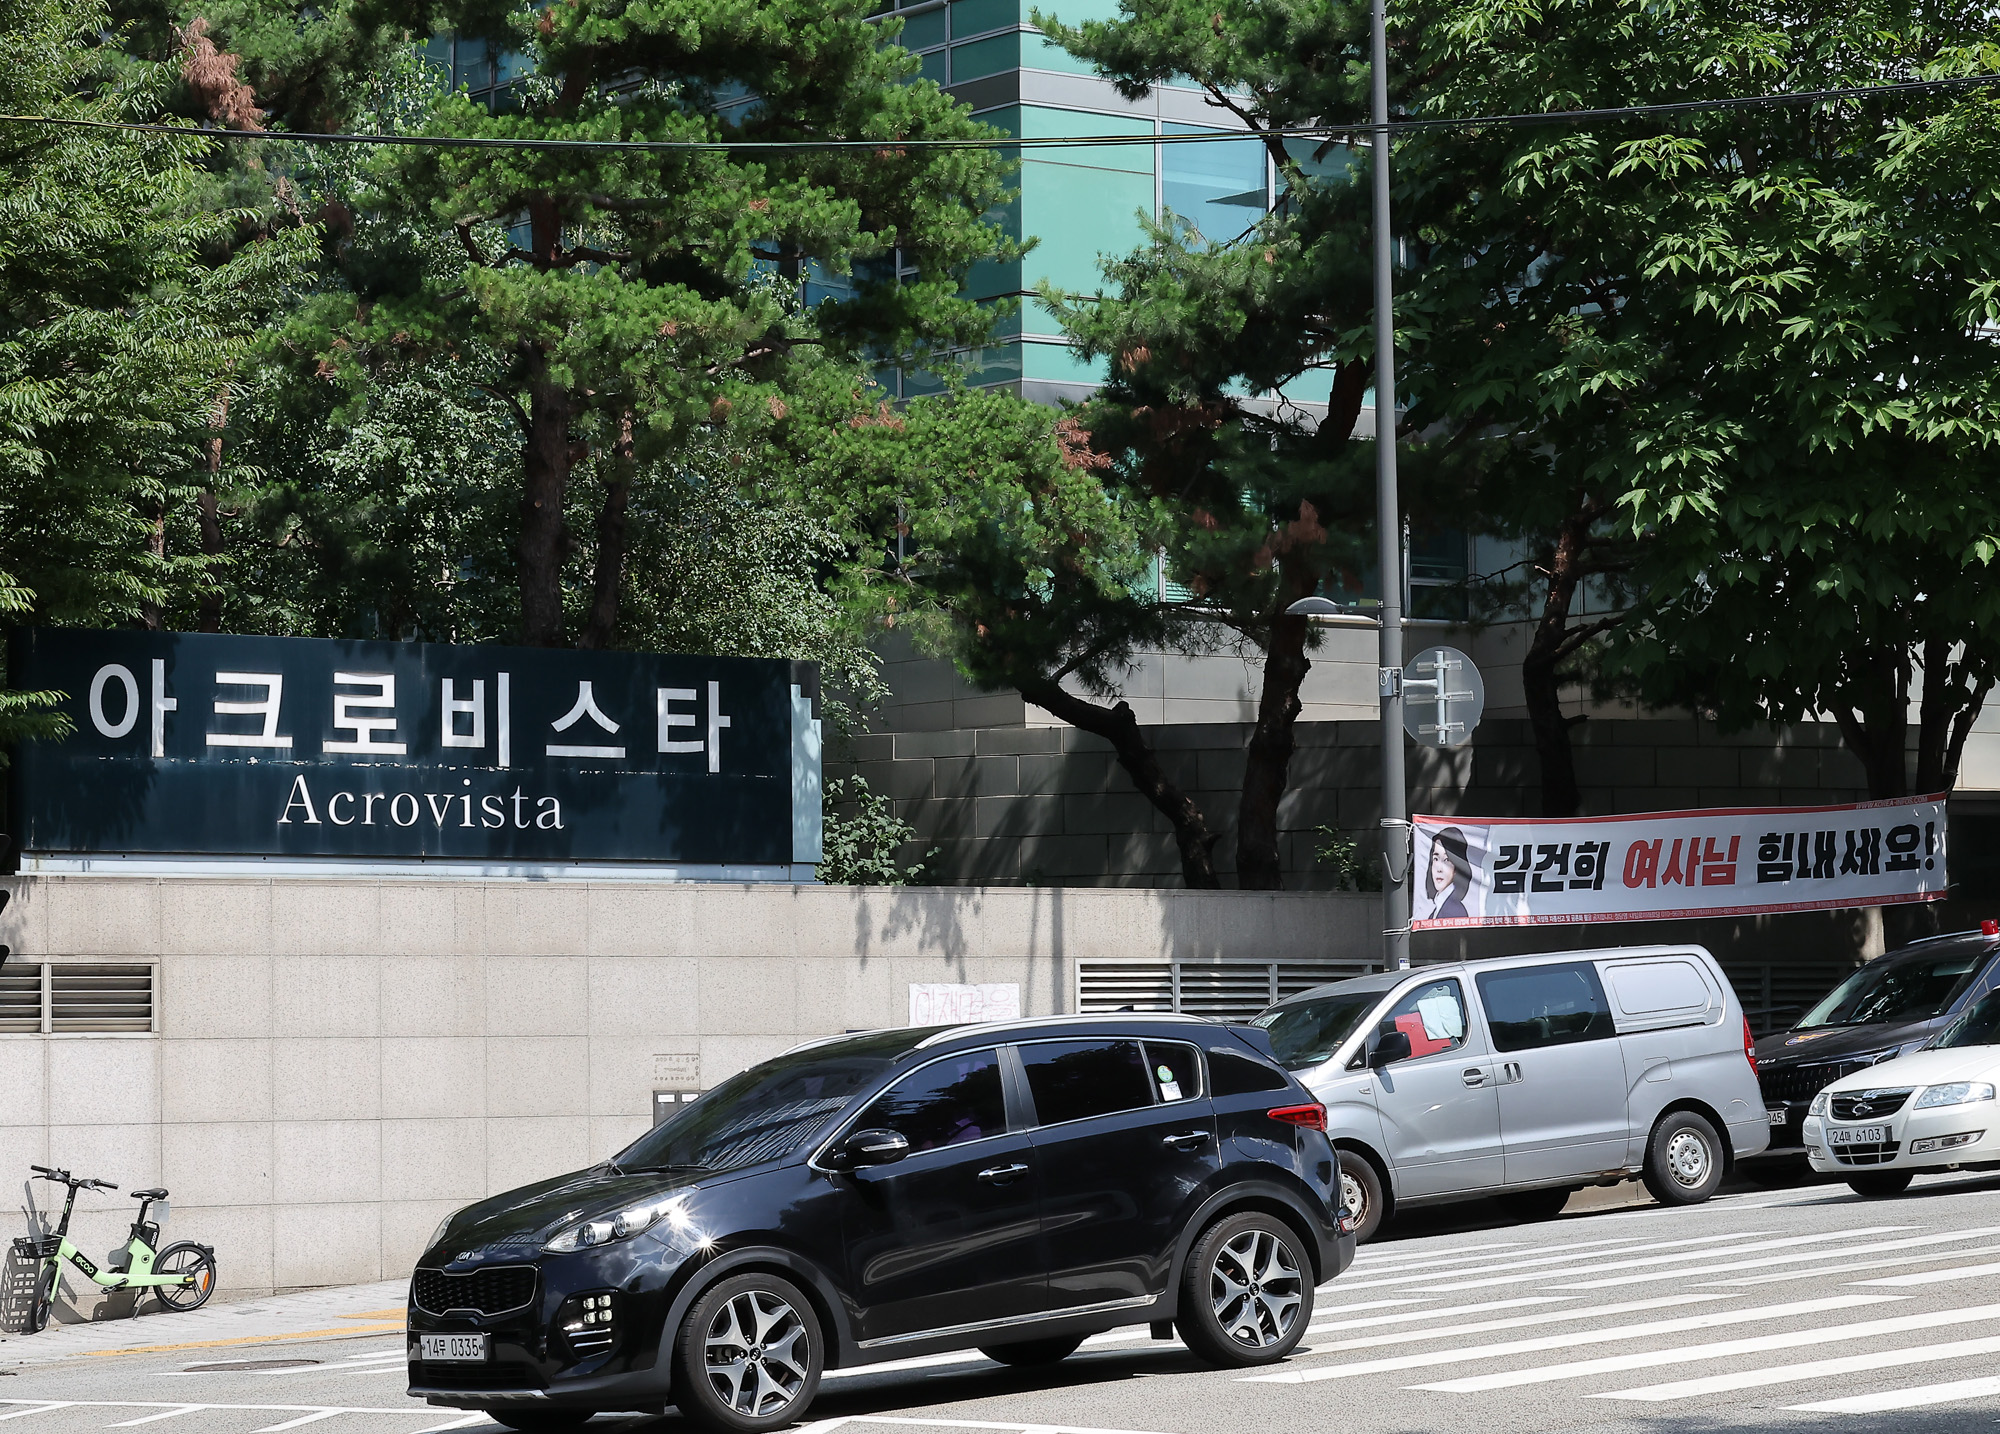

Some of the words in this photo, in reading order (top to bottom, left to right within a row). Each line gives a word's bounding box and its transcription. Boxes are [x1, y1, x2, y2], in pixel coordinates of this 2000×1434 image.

[88, 658, 731, 773] 아크로비스타
[277, 774, 565, 830] Acrovista
[1493, 841, 1611, 894] 김건희
[1622, 835, 1741, 889] 여사님
[1757, 821, 1935, 884] 힘내세요!
[1856, 1128, 1881, 1142] 6103
[75, 1255, 95, 1274] GCOO
[426, 1338, 446, 1357] 14무
[451, 1337, 479, 1357] 0335
